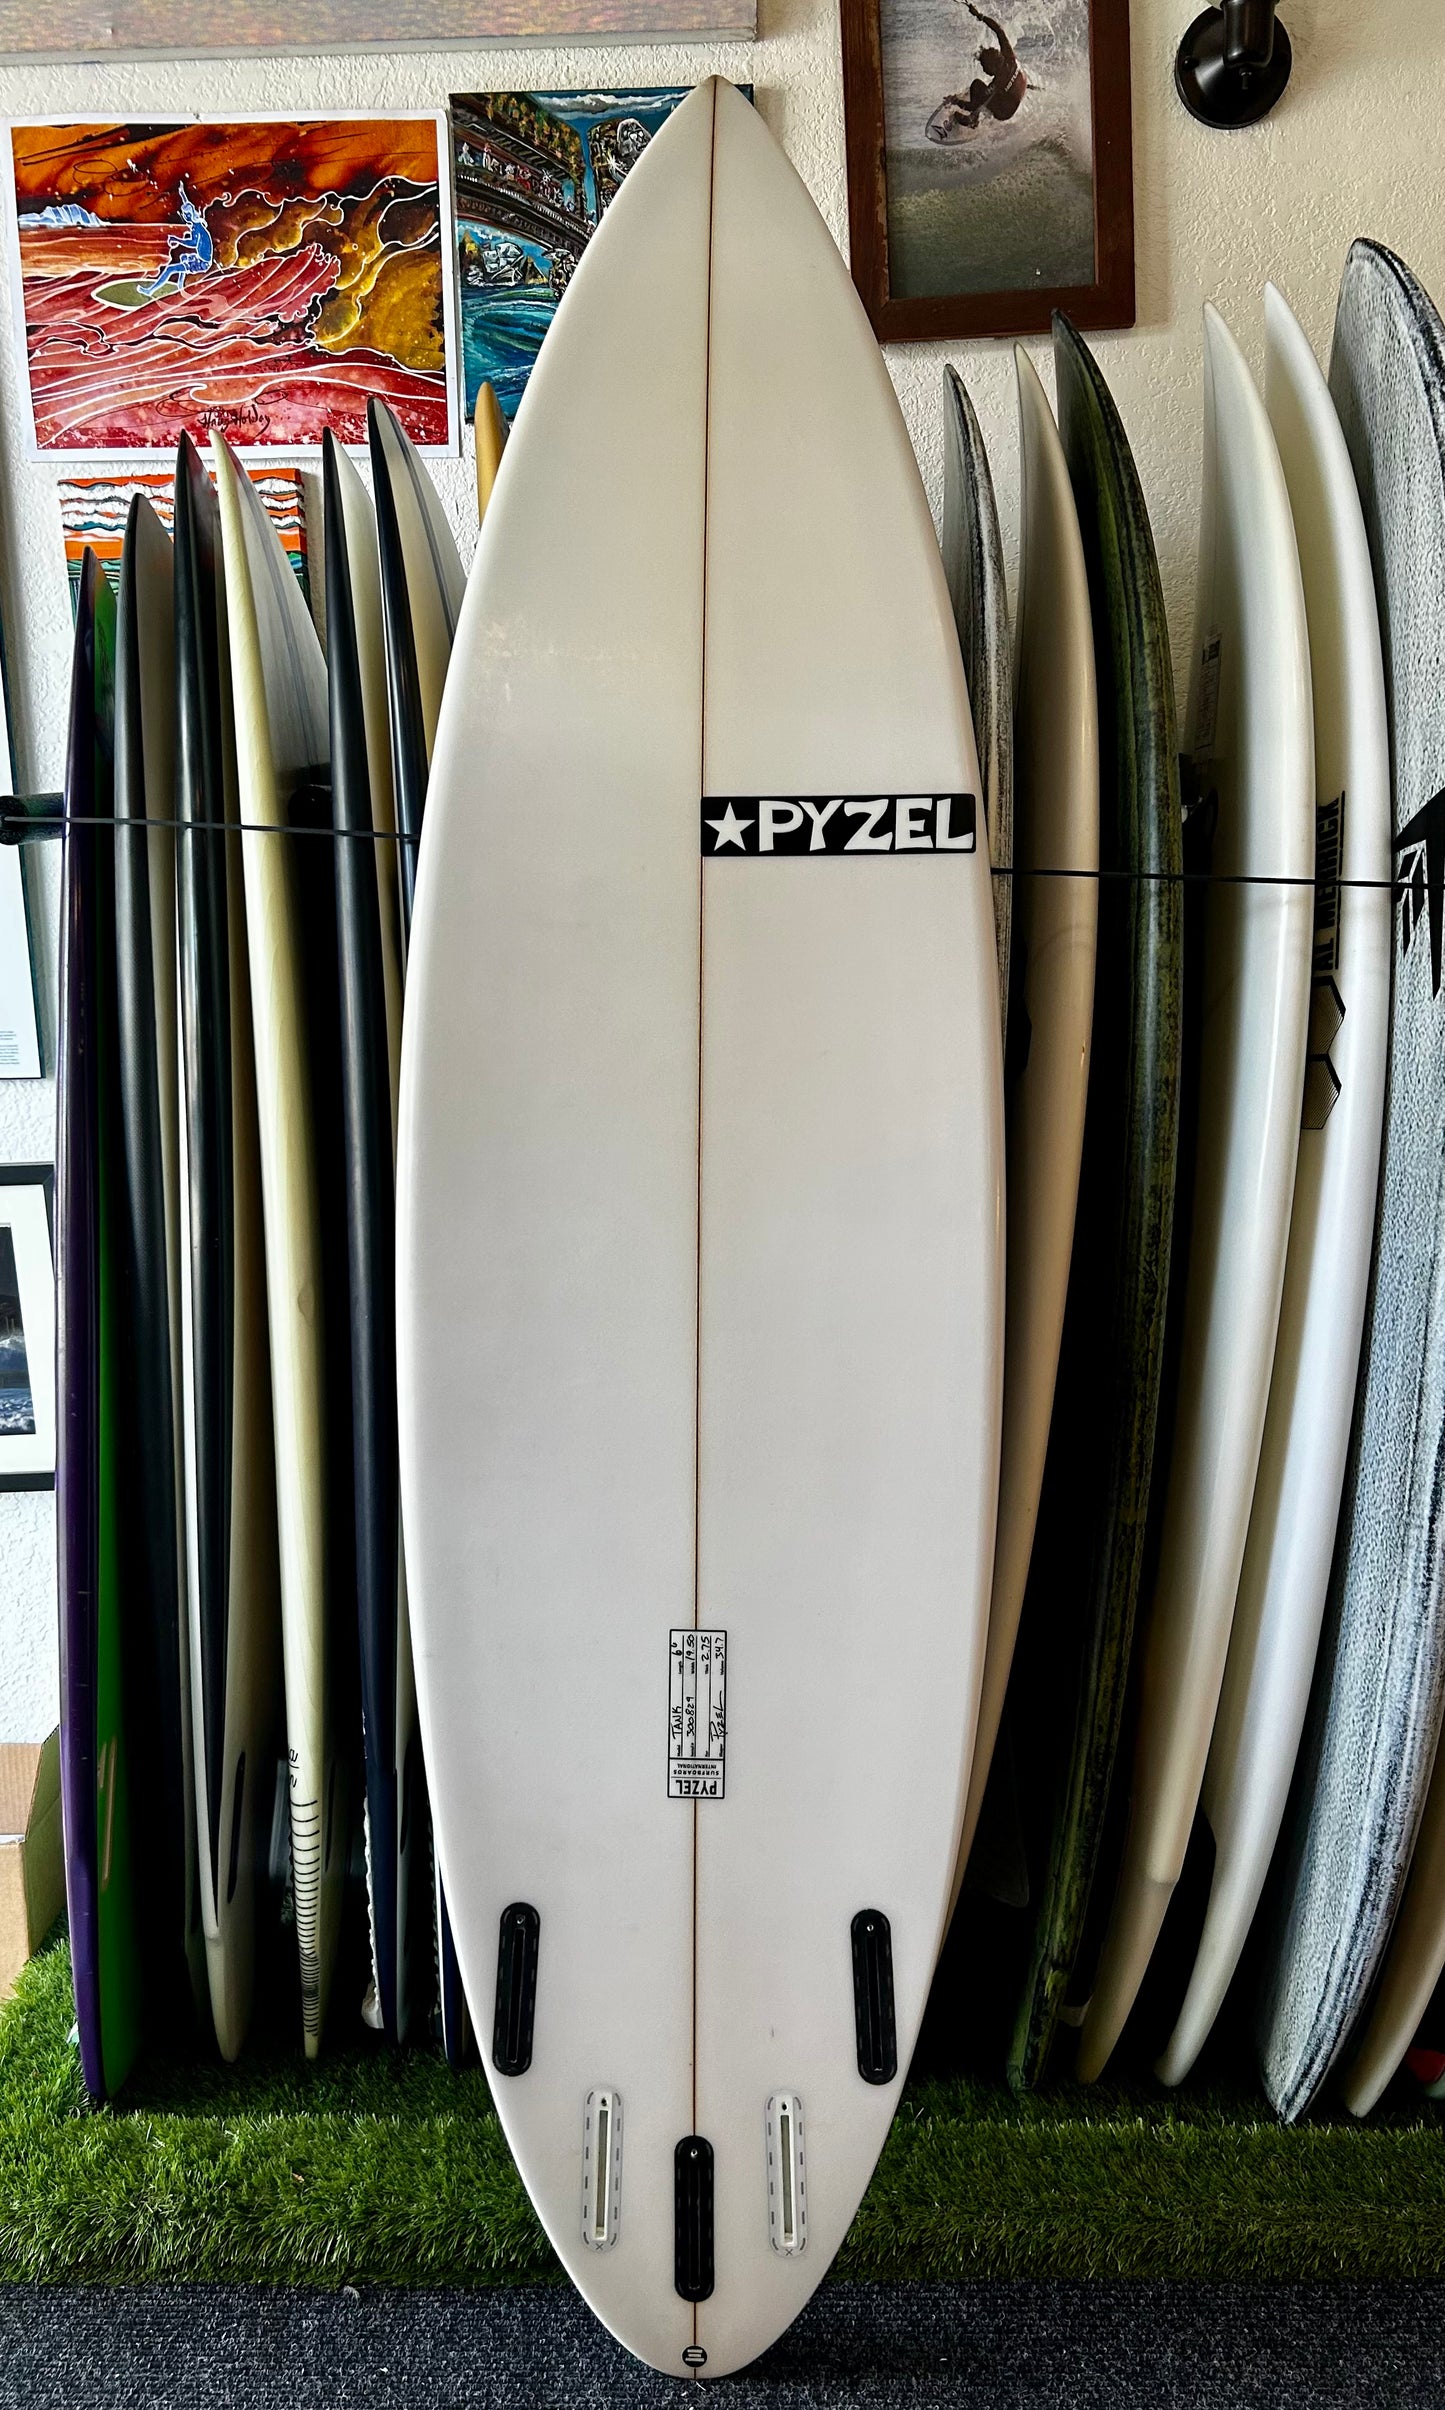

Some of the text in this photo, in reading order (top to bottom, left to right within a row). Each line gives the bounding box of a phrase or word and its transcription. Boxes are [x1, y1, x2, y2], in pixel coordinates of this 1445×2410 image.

[759, 798, 974, 852] PYZEL
[1312, 937, 1334, 971] AL
[685, 1633, 696, 1661] 19.50
[701, 1635, 711, 1662] 2.75
[671, 1705, 683, 1740] TANK
[673, 1769, 720, 1777] SURFBOARDS
[676, 1762, 717, 1770] INTERNATIONAL
[675, 1780, 718, 1796] PYZEL
